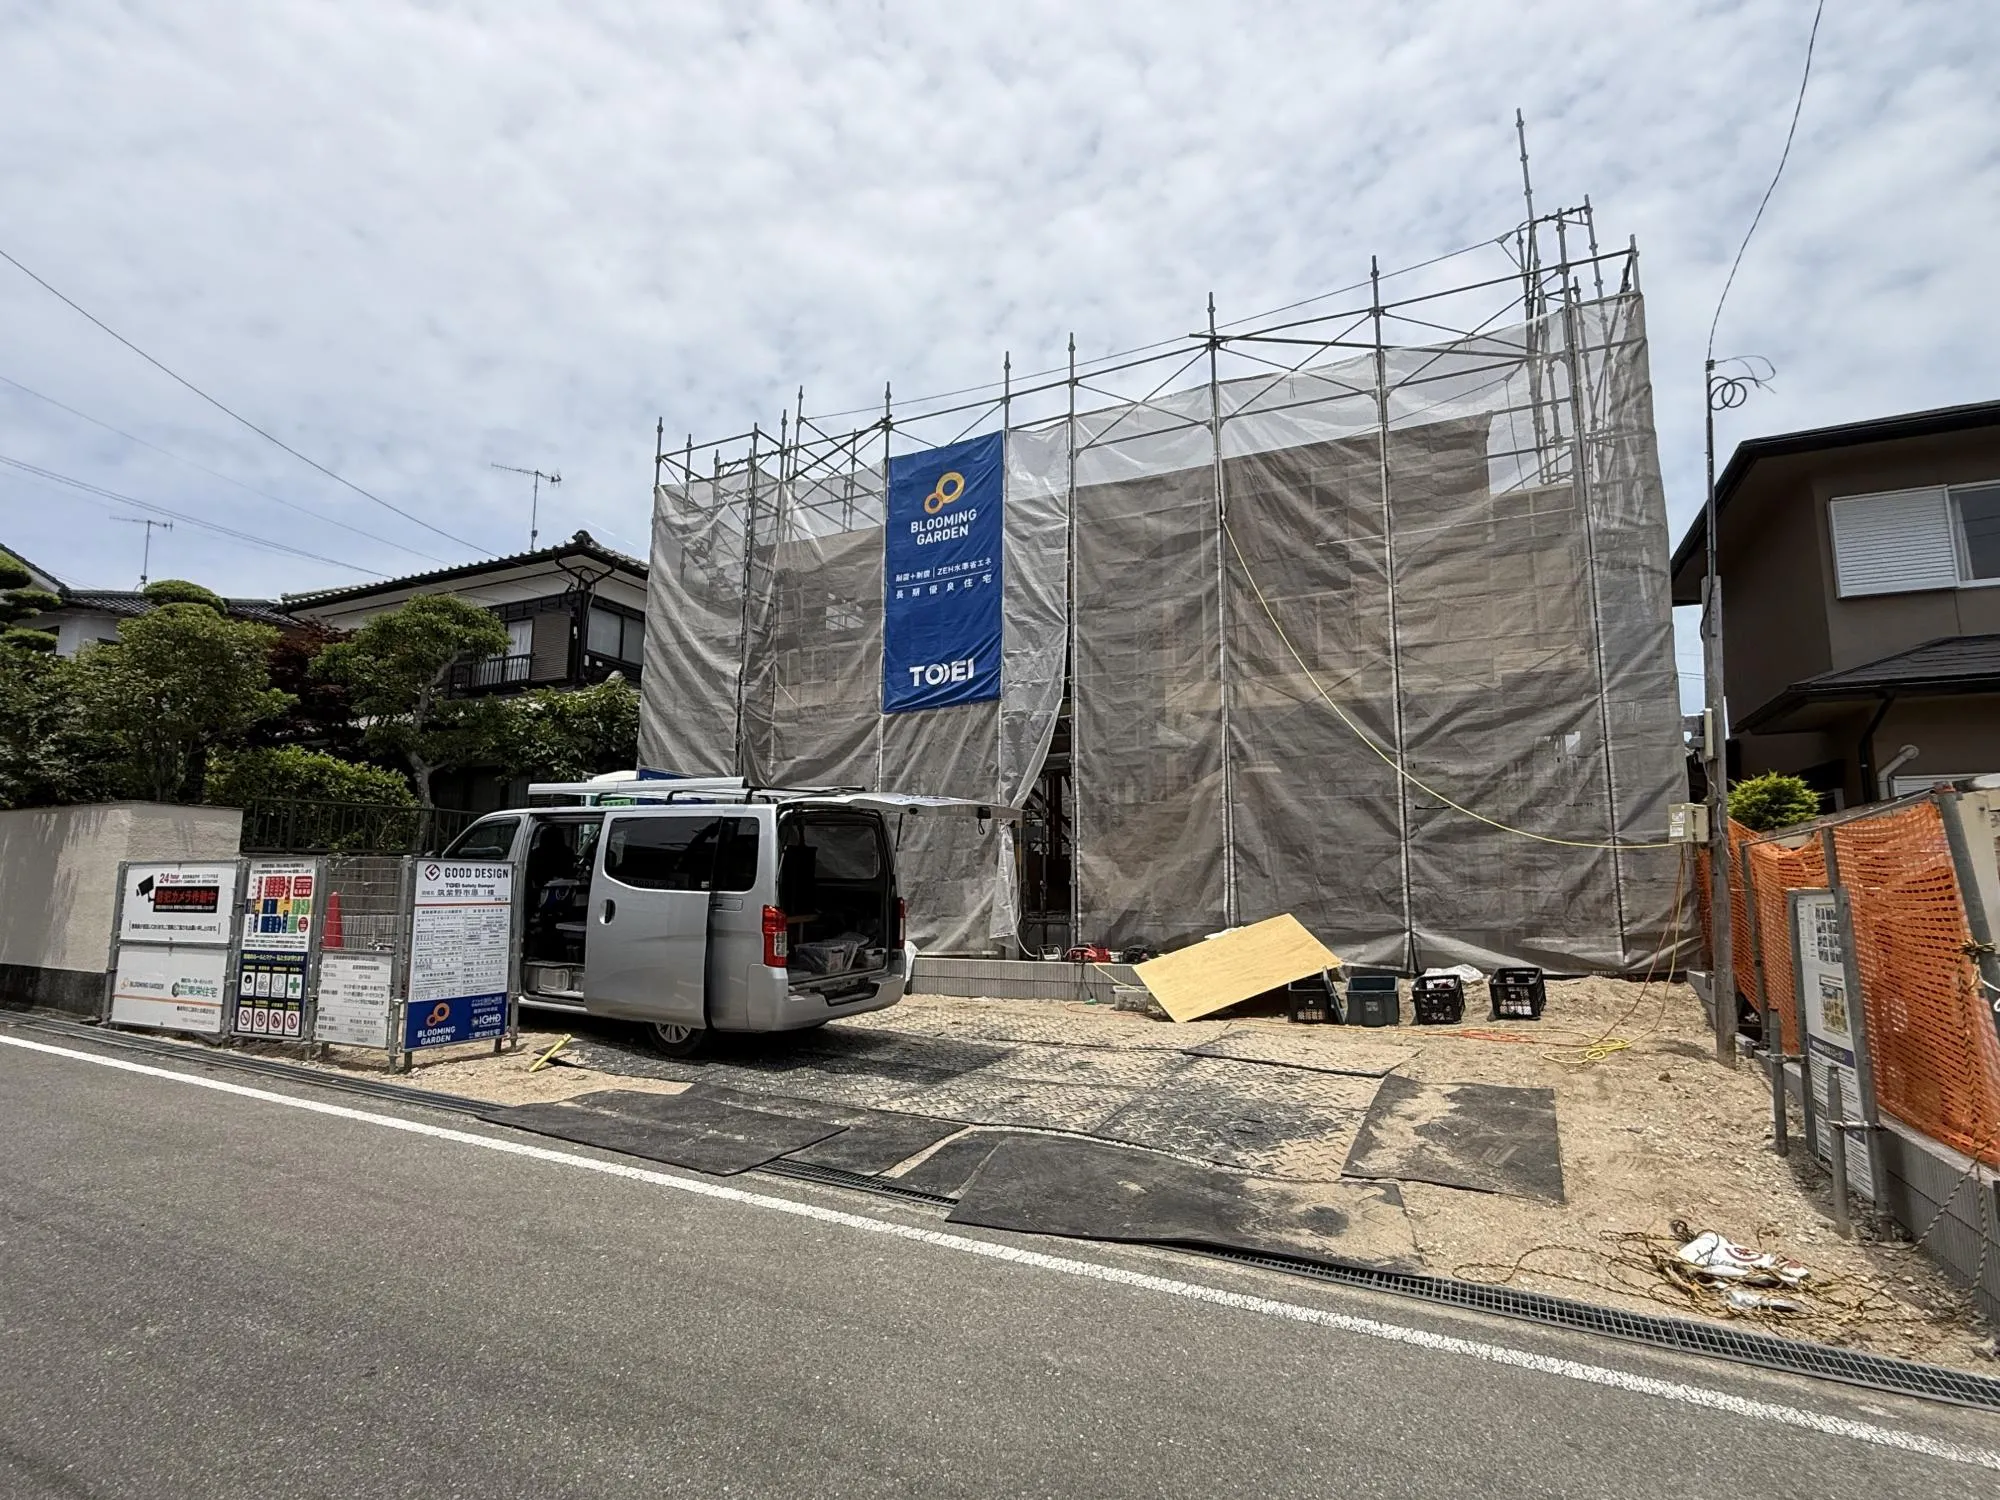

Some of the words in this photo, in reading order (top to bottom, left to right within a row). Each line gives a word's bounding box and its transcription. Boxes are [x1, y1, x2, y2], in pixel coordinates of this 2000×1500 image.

[910, 509, 977, 533] BLOOMING
[917, 524, 969, 545] GARDEN
[909, 658, 975, 686] TOEI
[159, 873, 170, 883] 24
[445, 867, 472, 878] GOOD
[475, 868, 509, 878] DESIGN
[417, 1026, 456, 1038] BLOOMING
[420, 1035, 452, 1045] GARDEN
